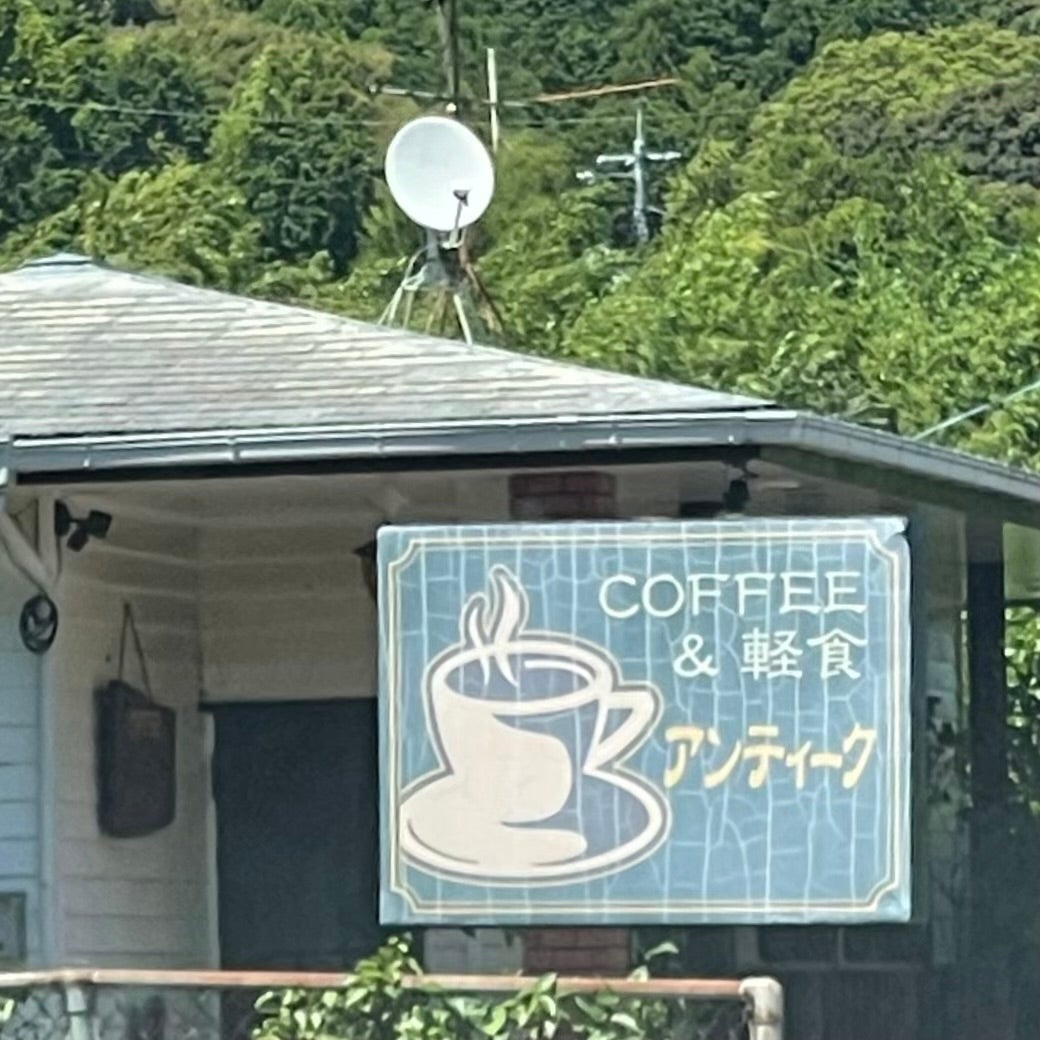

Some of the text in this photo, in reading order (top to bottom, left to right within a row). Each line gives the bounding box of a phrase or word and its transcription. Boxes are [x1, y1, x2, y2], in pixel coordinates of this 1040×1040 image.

[598, 570, 868, 619] COFFEE
[672, 627, 868, 680] & 軽食
[663, 724, 877, 789] アンティーク
